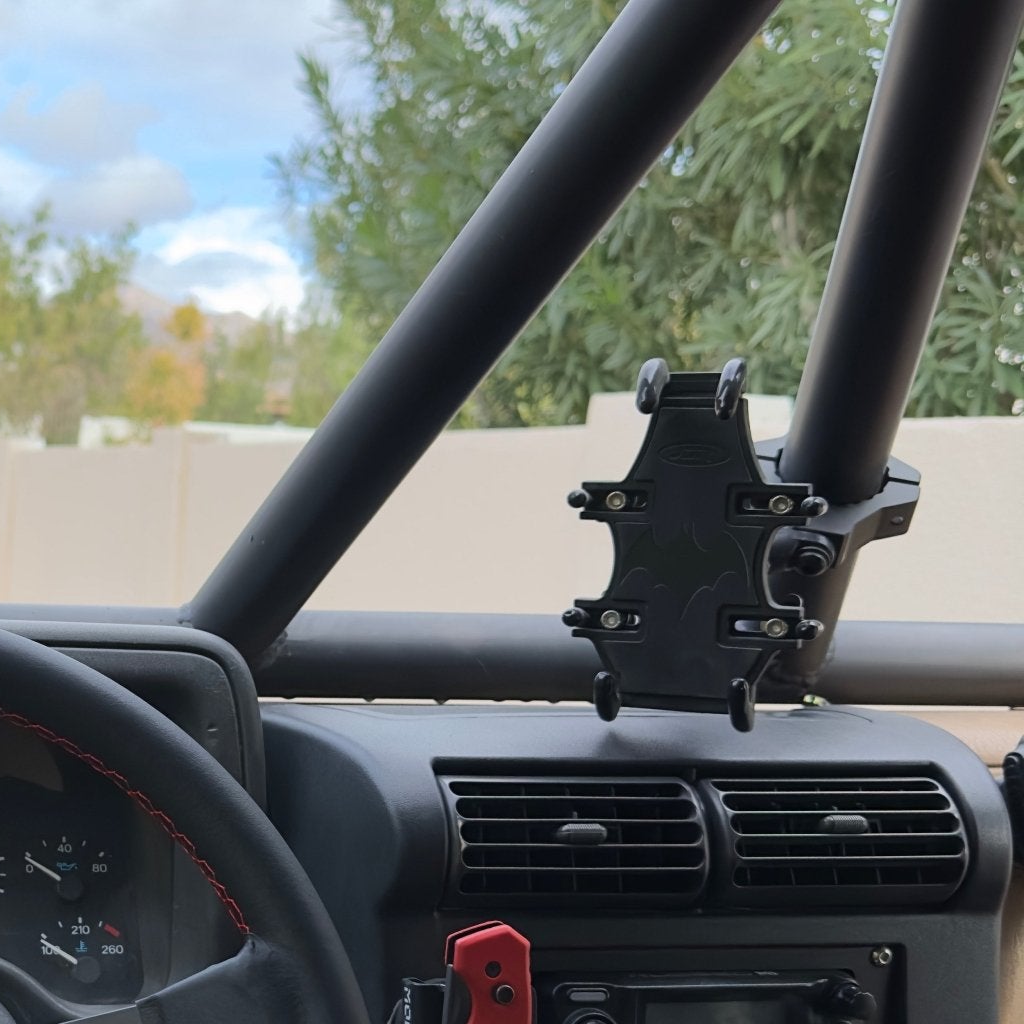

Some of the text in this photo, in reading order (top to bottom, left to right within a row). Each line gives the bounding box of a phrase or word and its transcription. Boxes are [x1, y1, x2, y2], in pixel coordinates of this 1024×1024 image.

[57, 844, 72, 853] 40
[25, 864, 34, 874] 0
[92, 863, 107, 873] 80
[71, 925, 90, 935] 210
[101, 945, 124, 955] 260
